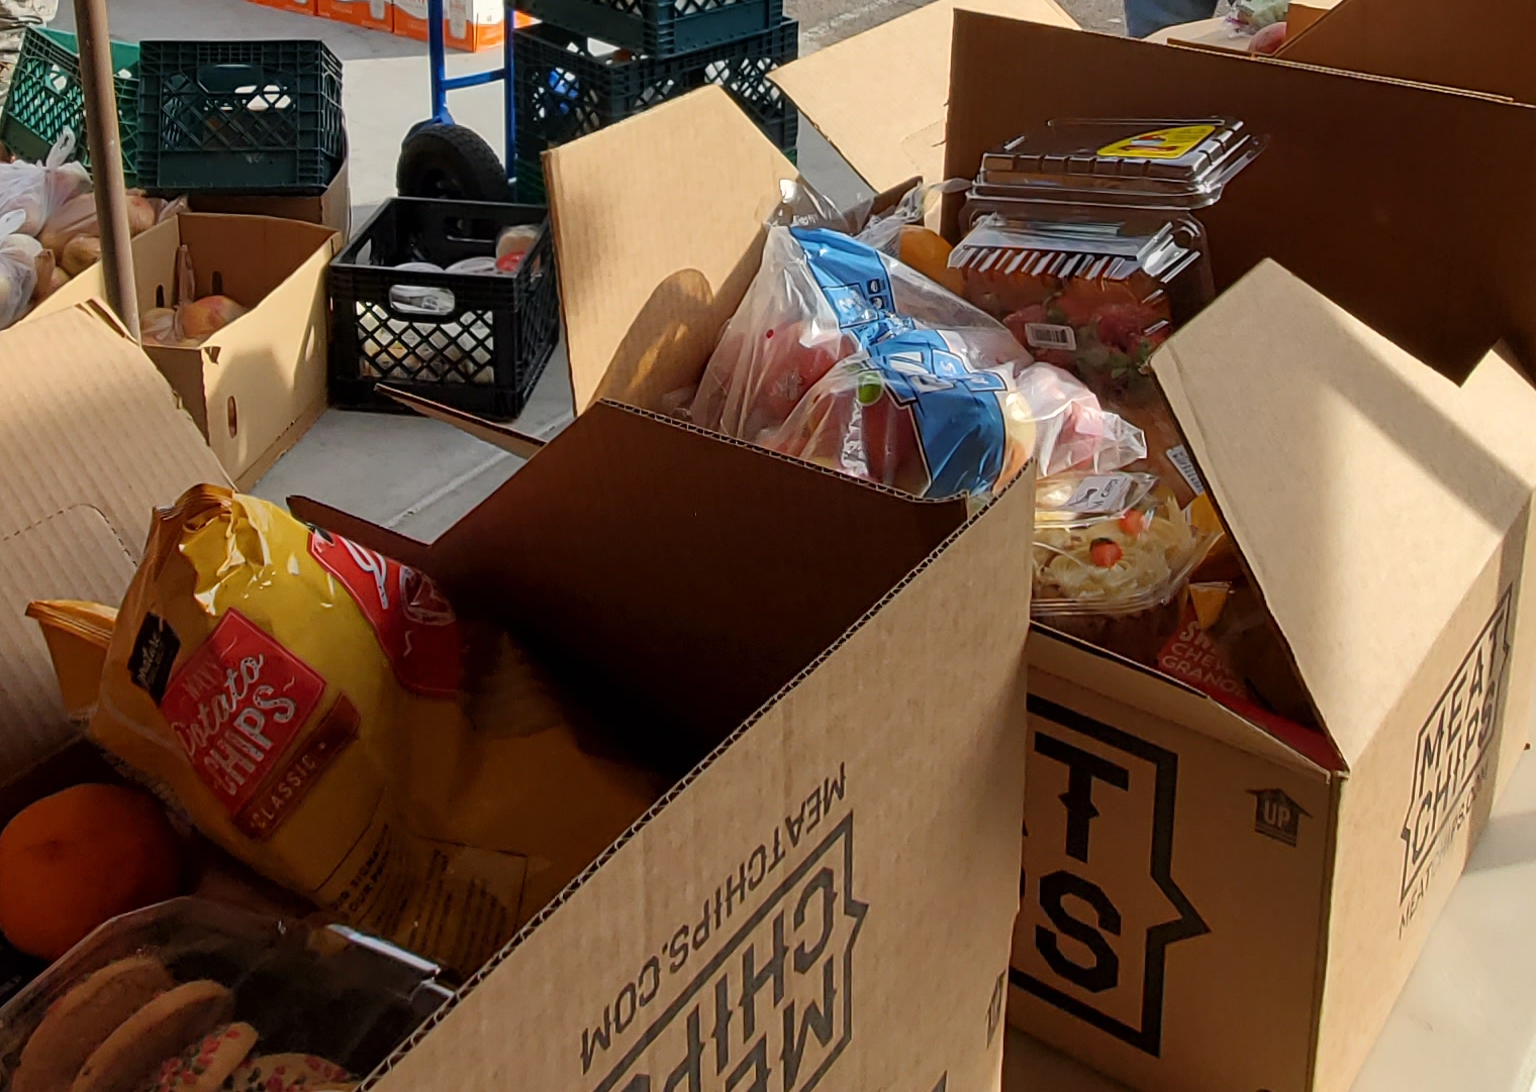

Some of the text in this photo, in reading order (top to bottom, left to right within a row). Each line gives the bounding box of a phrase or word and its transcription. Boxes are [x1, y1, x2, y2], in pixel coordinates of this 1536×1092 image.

[170, 653, 264, 757] Potato
[203, 684, 296, 796] CHIPS
[1419, 609, 1504, 799] MEAT
[253, 753, 316, 830] CLASSIC
[1263, 800, 1291, 828] UP
[1413, 678, 1496, 865] CHIPS
[580, 761, 847, 1076] MEATCHIPS.COM
